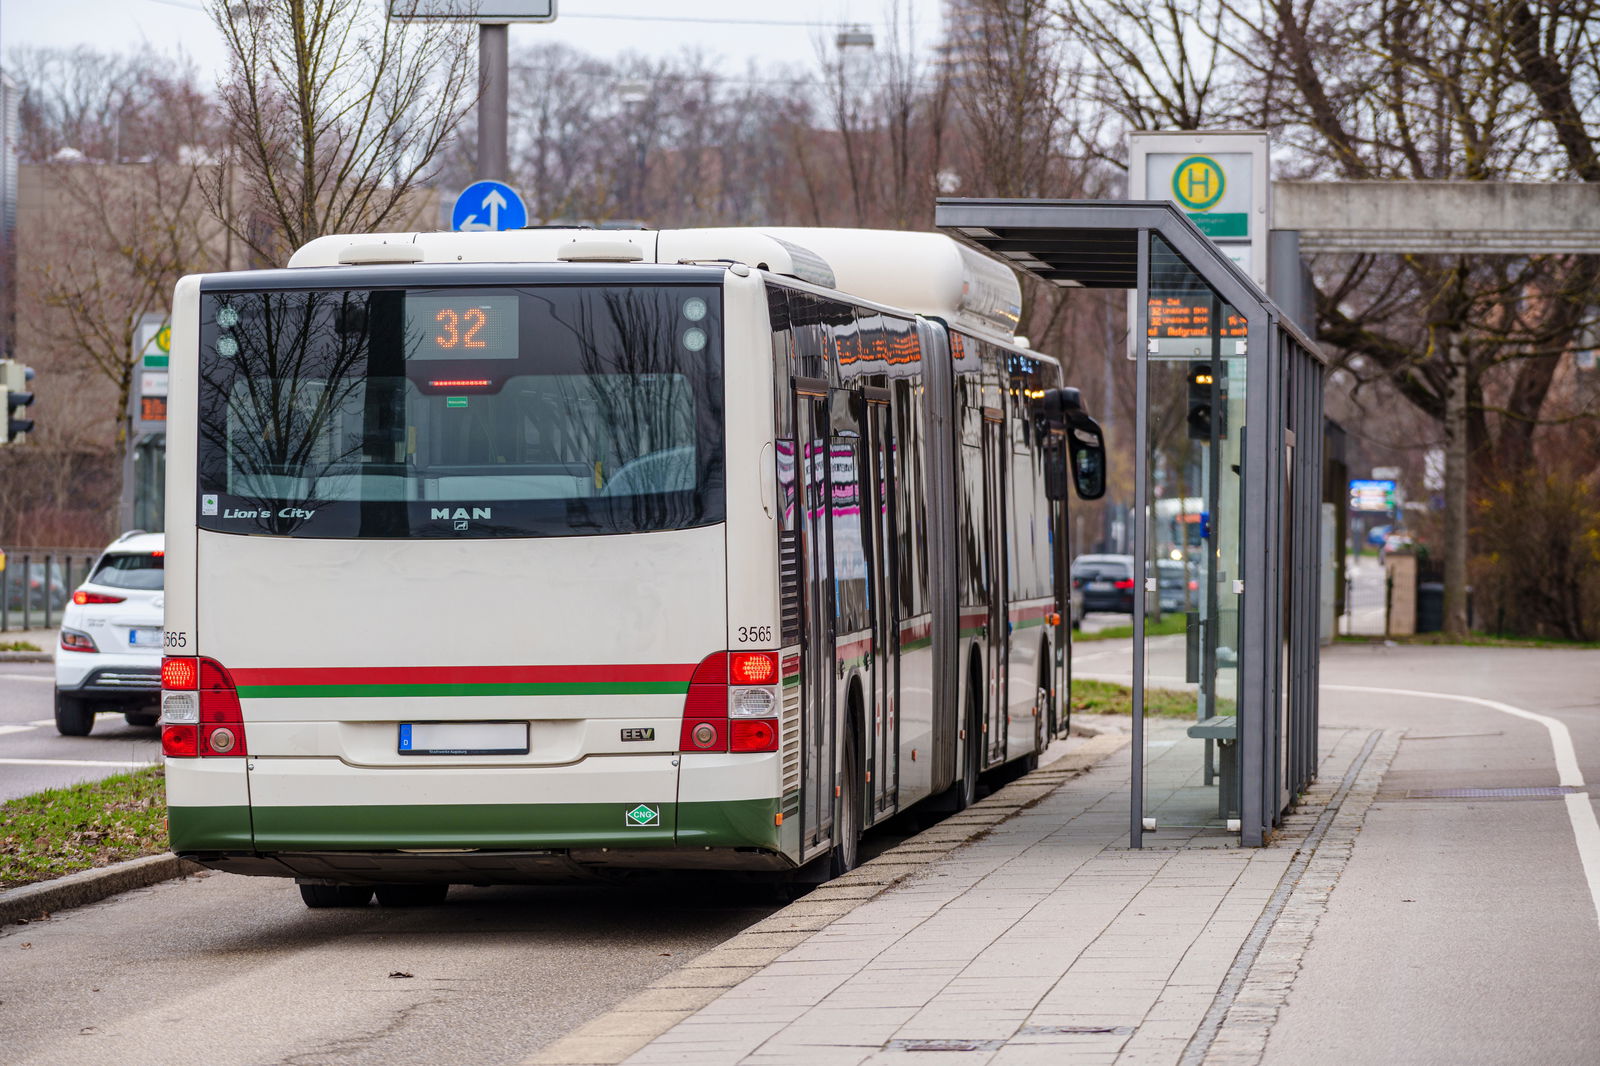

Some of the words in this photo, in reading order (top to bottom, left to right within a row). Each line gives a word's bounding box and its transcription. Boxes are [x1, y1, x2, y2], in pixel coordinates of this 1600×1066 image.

[1188, 168, 1209, 198] H
[436, 309, 486, 348] 32
[223, 507, 272, 519] Lion's
[278, 507, 316, 520] City
[431, 507, 491, 520] MAN
[164, 631, 187, 648] 565
[738, 626, 772, 643] 3565
[622, 729, 653, 739] EEV
